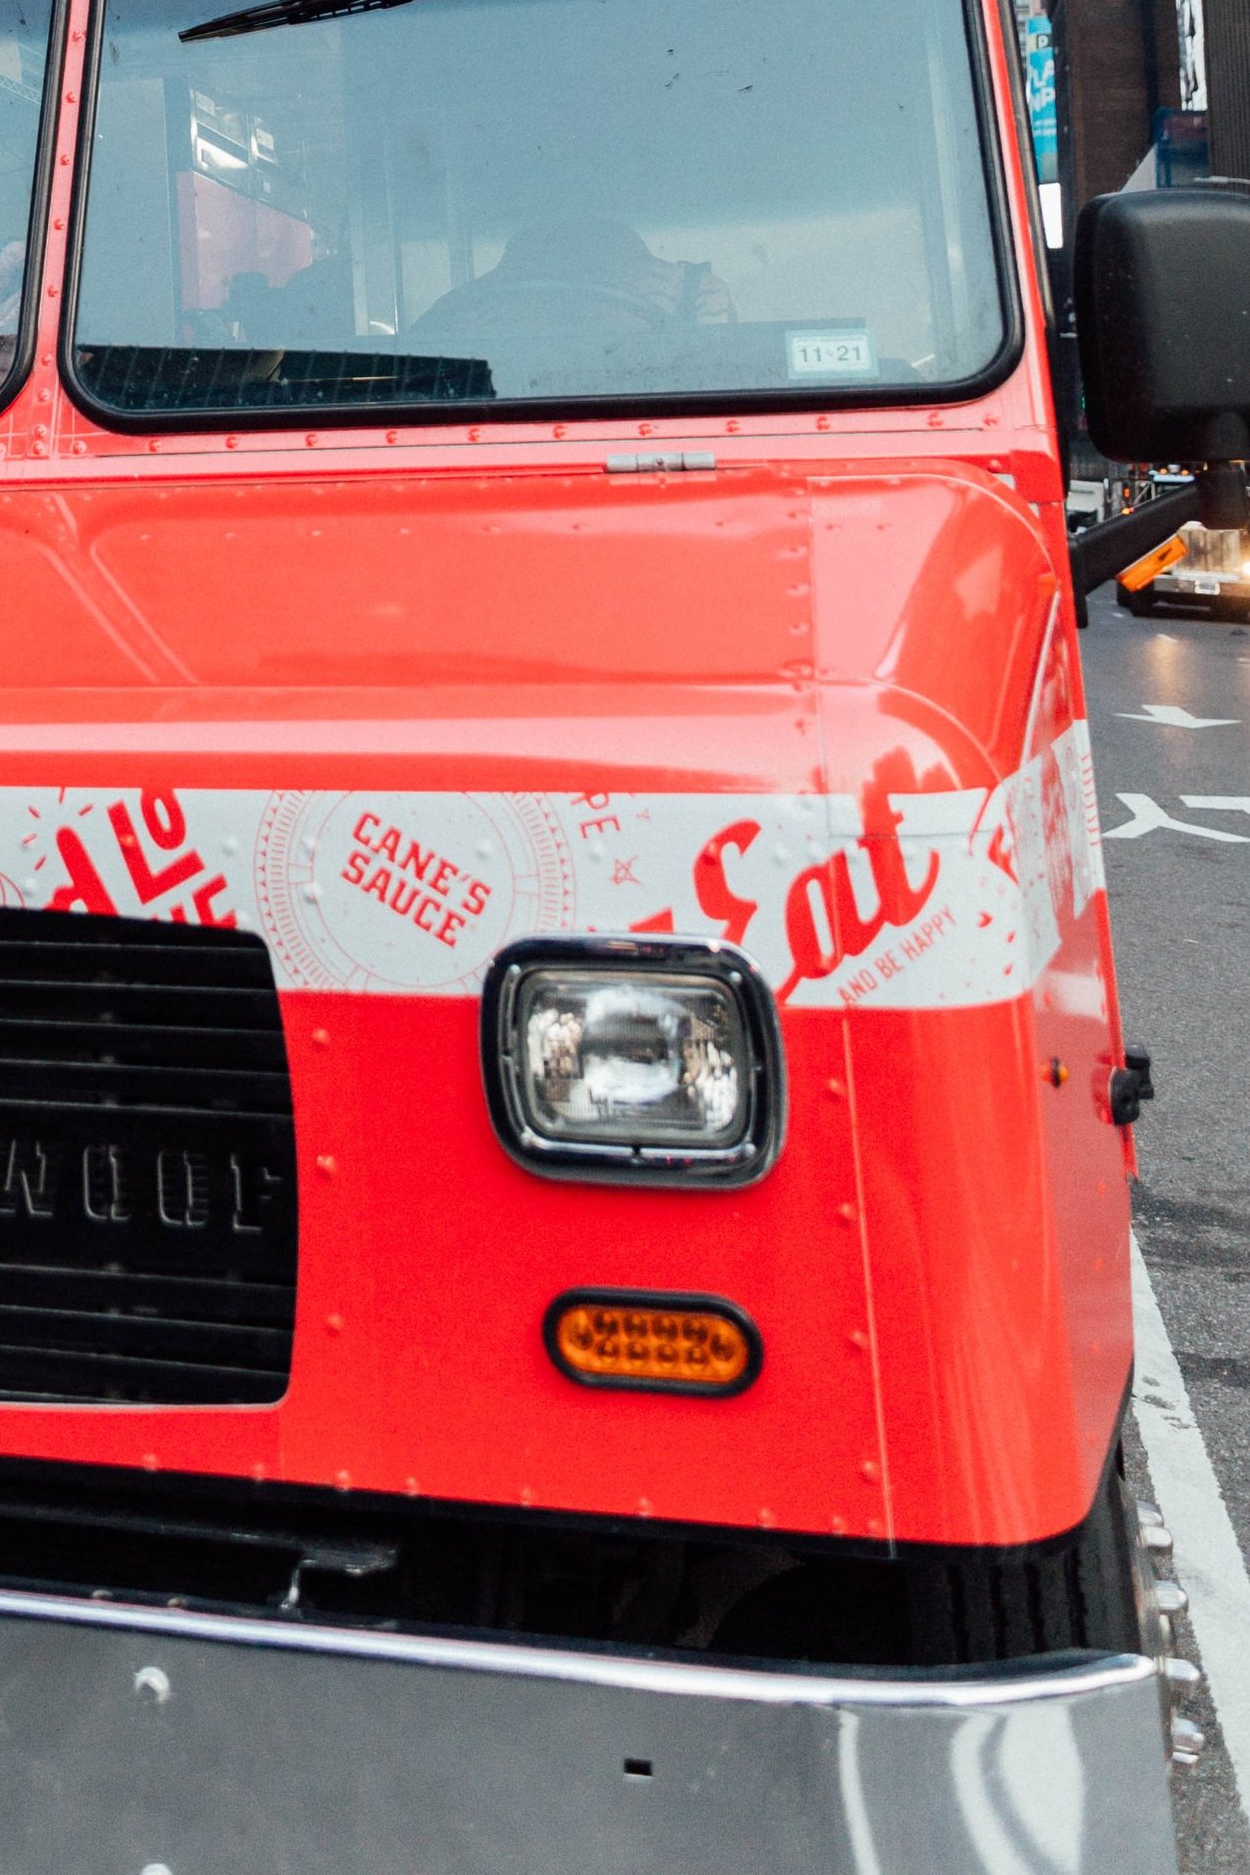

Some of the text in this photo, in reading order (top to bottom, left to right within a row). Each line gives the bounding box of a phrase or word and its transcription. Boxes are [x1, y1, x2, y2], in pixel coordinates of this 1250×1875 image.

[341, 850, 466, 949] SAUCE
[352, 811, 493, 916] CANE'S
[838, 904, 957, 1005] AND BE HAPPY
